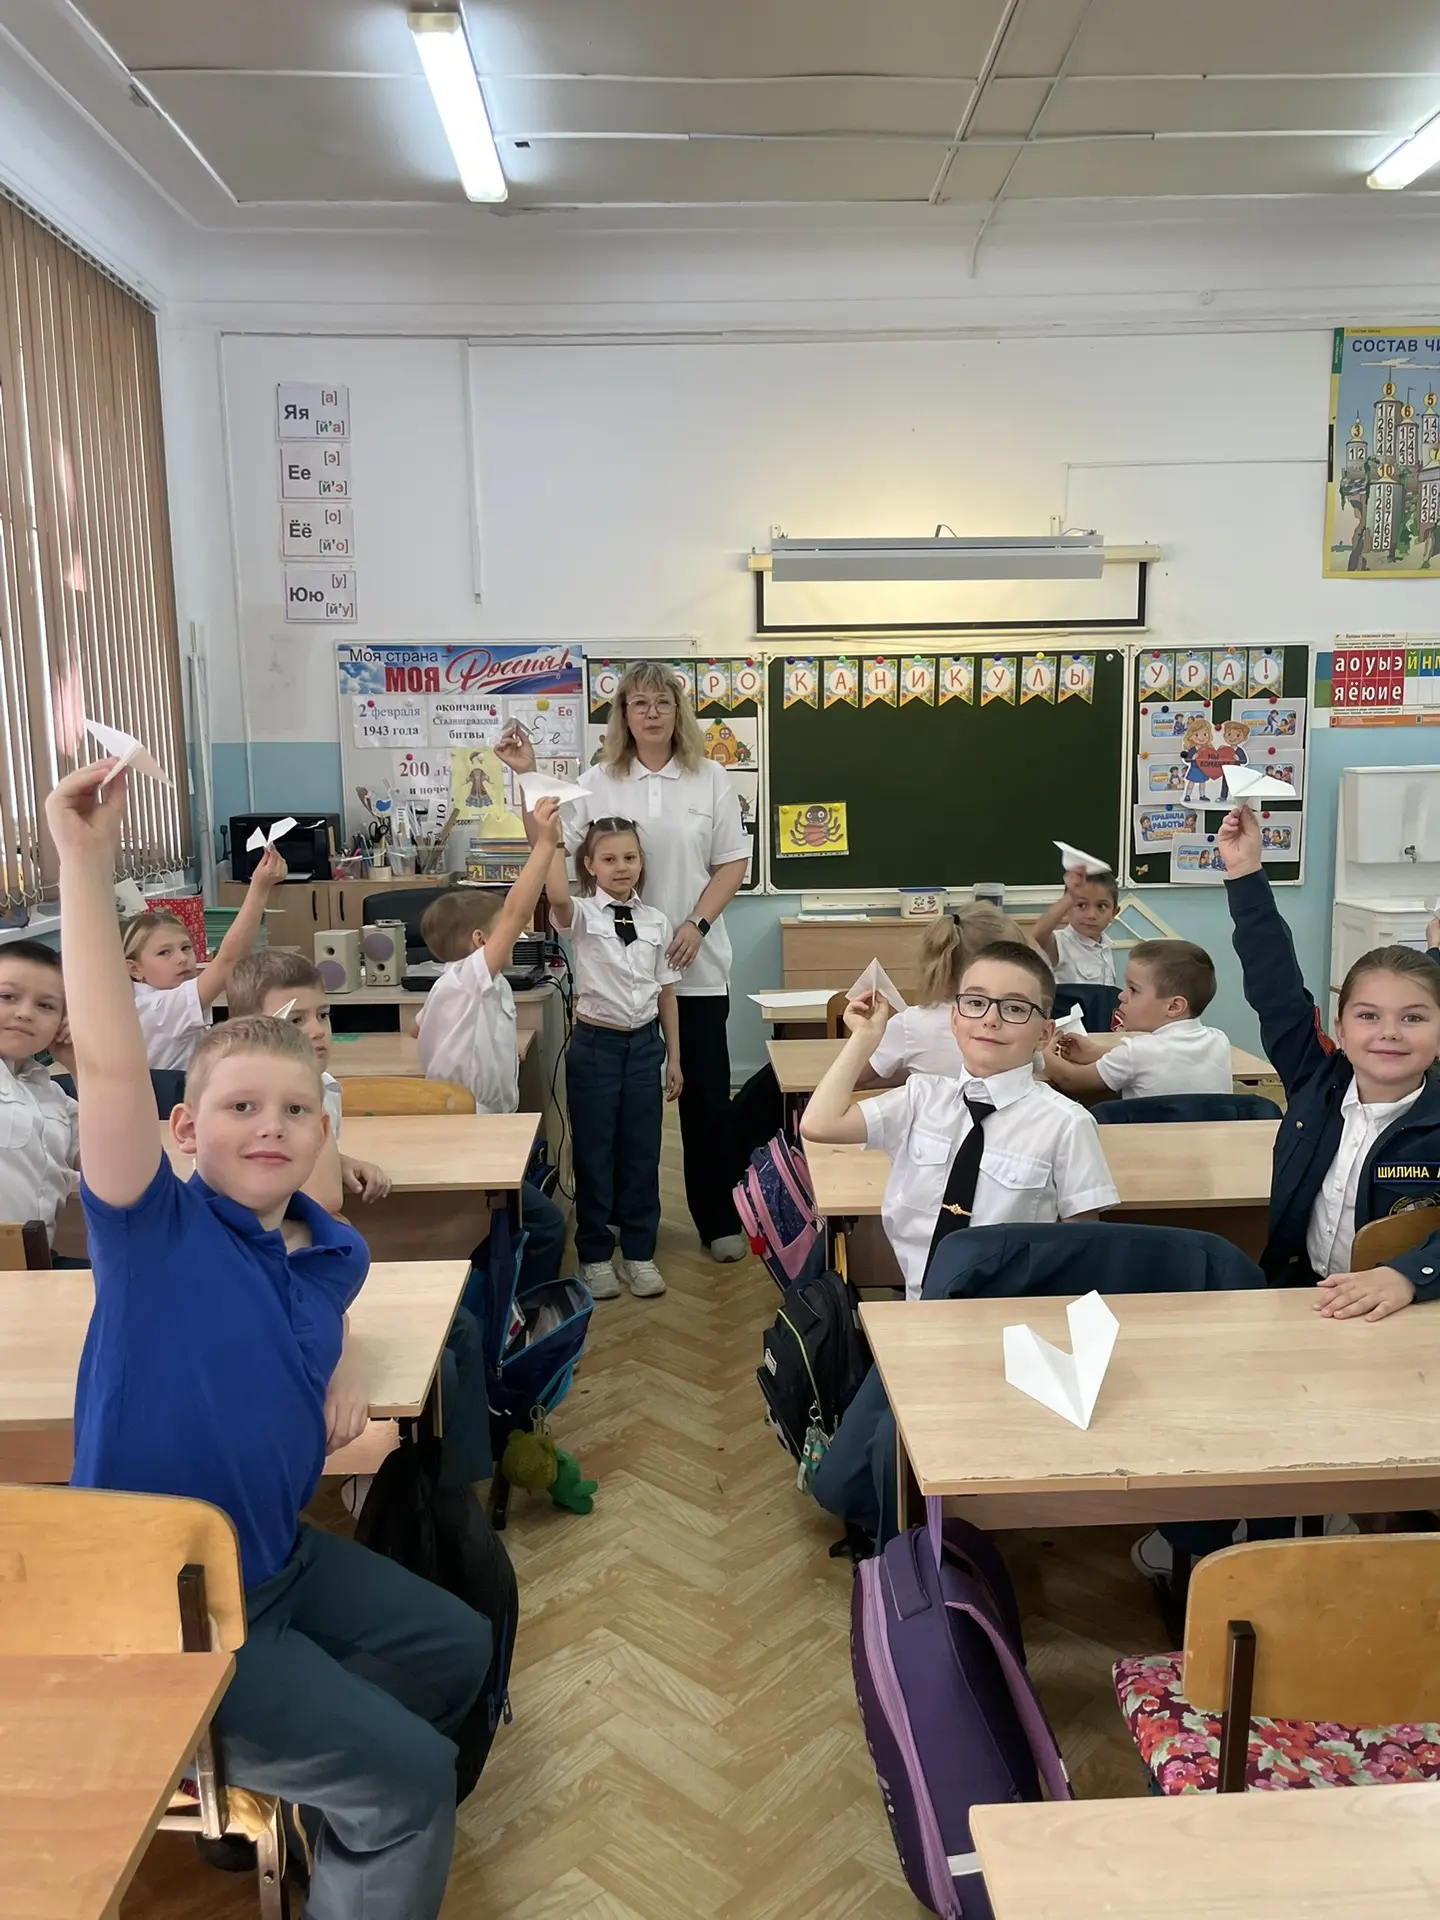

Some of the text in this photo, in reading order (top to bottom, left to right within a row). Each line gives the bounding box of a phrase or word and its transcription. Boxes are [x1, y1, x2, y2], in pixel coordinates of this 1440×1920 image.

[1352, 340, 1418, 353] СОСТАВ
[1386, 383, 1393, 392] 8
[1428, 394, 1433, 405] 5
[284, 405, 309, 420] Яя
[1404, 406, 1411, 417] 6
[1354, 425, 1360, 437] 3
[289, 465, 311, 480] Ее
[1380, 464, 1393, 476] 10
[290, 520, 312, 538] Ёё
[290, 587, 324, 602] Юю
[350, 649, 382, 662] Моя
[386, 651, 438, 664] страна
[445, 648, 570, 692] Россия!
[385, 667, 440, 692] МОЯ
[795, 668, 1085, 691] КАНИКУЛЫ
[359, 704, 420, 720] 2 февраля
[364, 726, 419, 736] 1943 года
[449, 730, 485, 739] битвы
[399, 761, 430, 777] 200
[1378, 1166, 1430, 1178] ШИЛИНА
